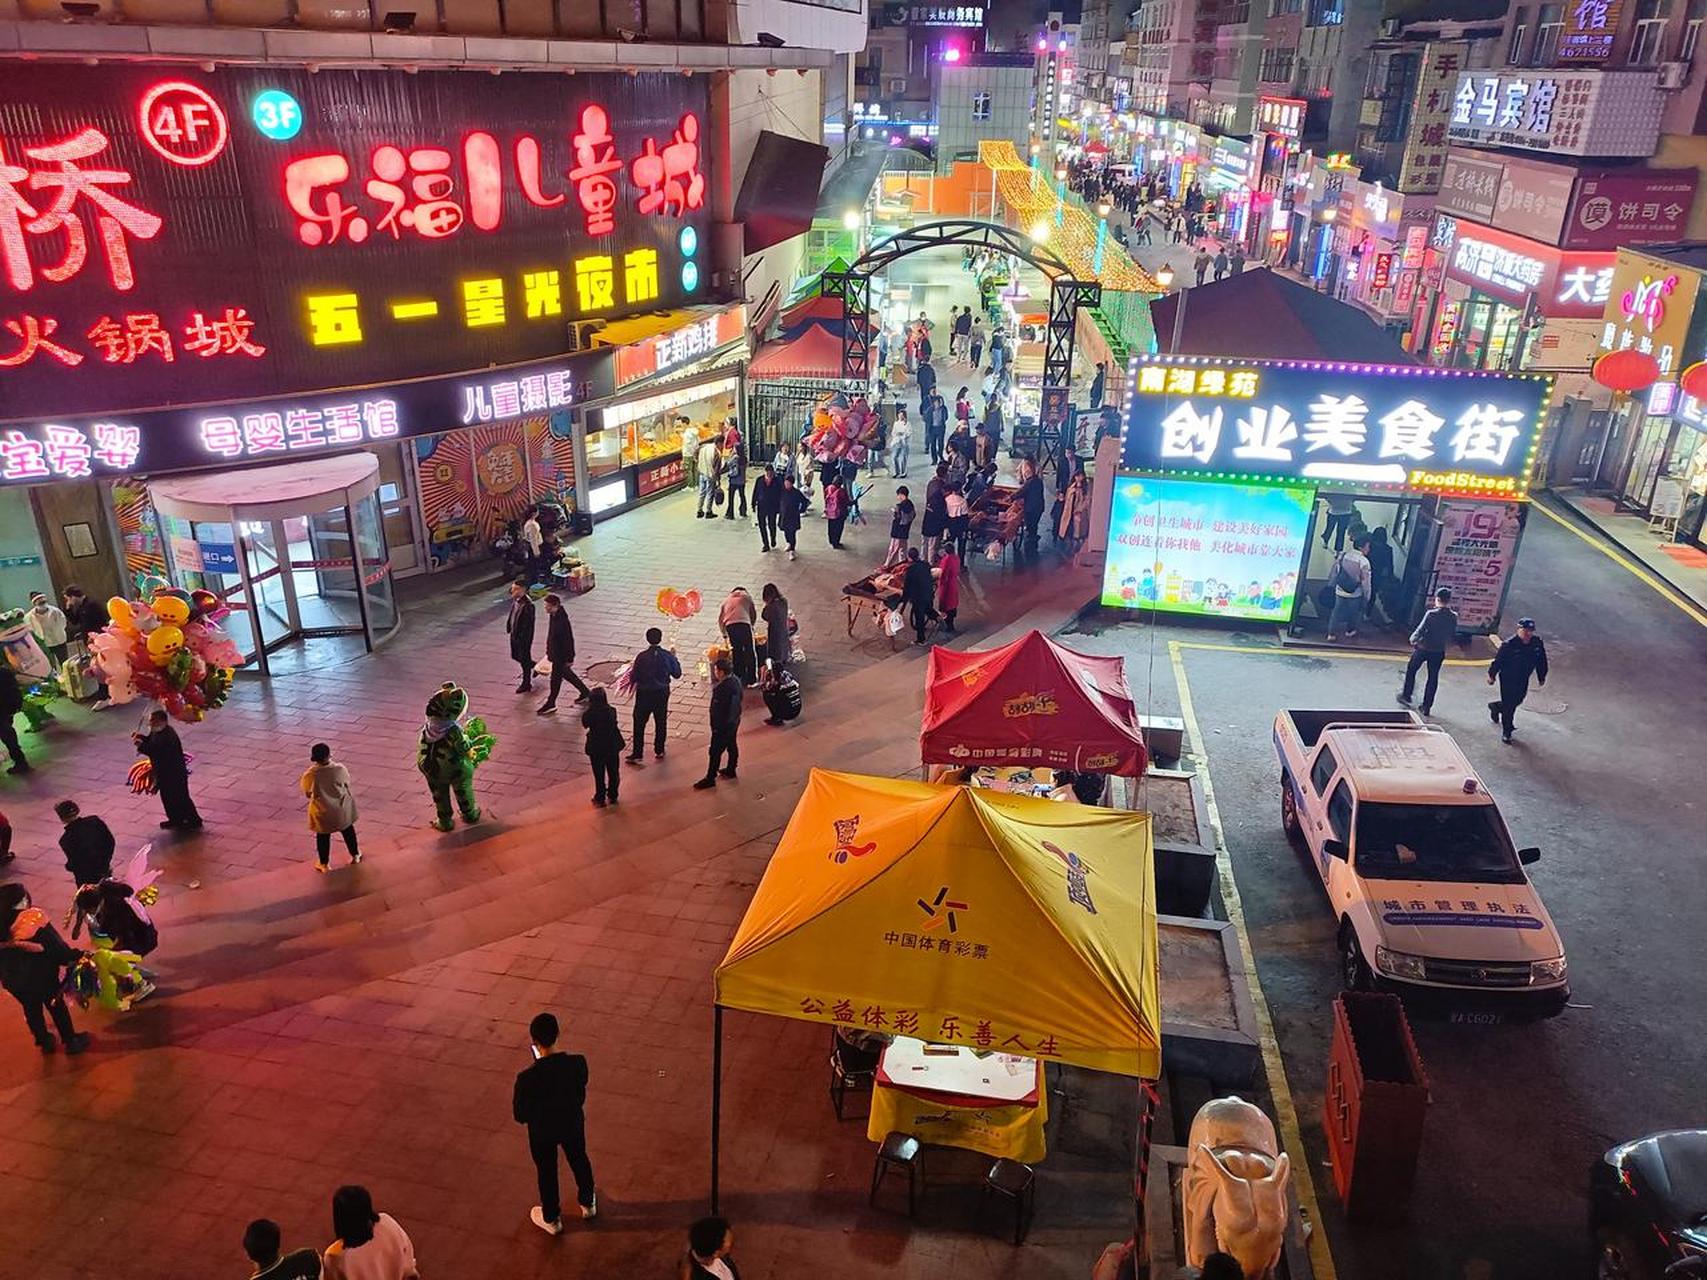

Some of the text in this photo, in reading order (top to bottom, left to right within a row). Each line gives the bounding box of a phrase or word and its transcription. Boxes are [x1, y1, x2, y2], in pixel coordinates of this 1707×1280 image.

[154, 103, 208, 144] 4F
[259, 100, 298, 129] 3F
[1419, 53, 1459, 147] 手机城
[1453, 76, 1558, 134] 金马宾馆
[284, 103, 706, 247] 乐福儿童城
[0, 128, 163, 292] 桥
[1616, 201, 1684, 221] 饼司令
[307, 248, 660, 347] 五一星光夜市
[0, 307, 267, 367] 火锅城
[655, 317, 718, 371] 正新鸡排
[462, 369, 573, 424] 儿童摄影
[0, 421, 143, 479] 宝爱婴
[199, 398, 400, 458] 母婴生活馆
[1160, 393, 1525, 467] 创业美食街
[1383, 900, 1532, 914] 城市管理执法
[884, 930, 991, 960] 中国体育彩票
[800, 996, 1063, 1058] 公益体彩 乐善人生
